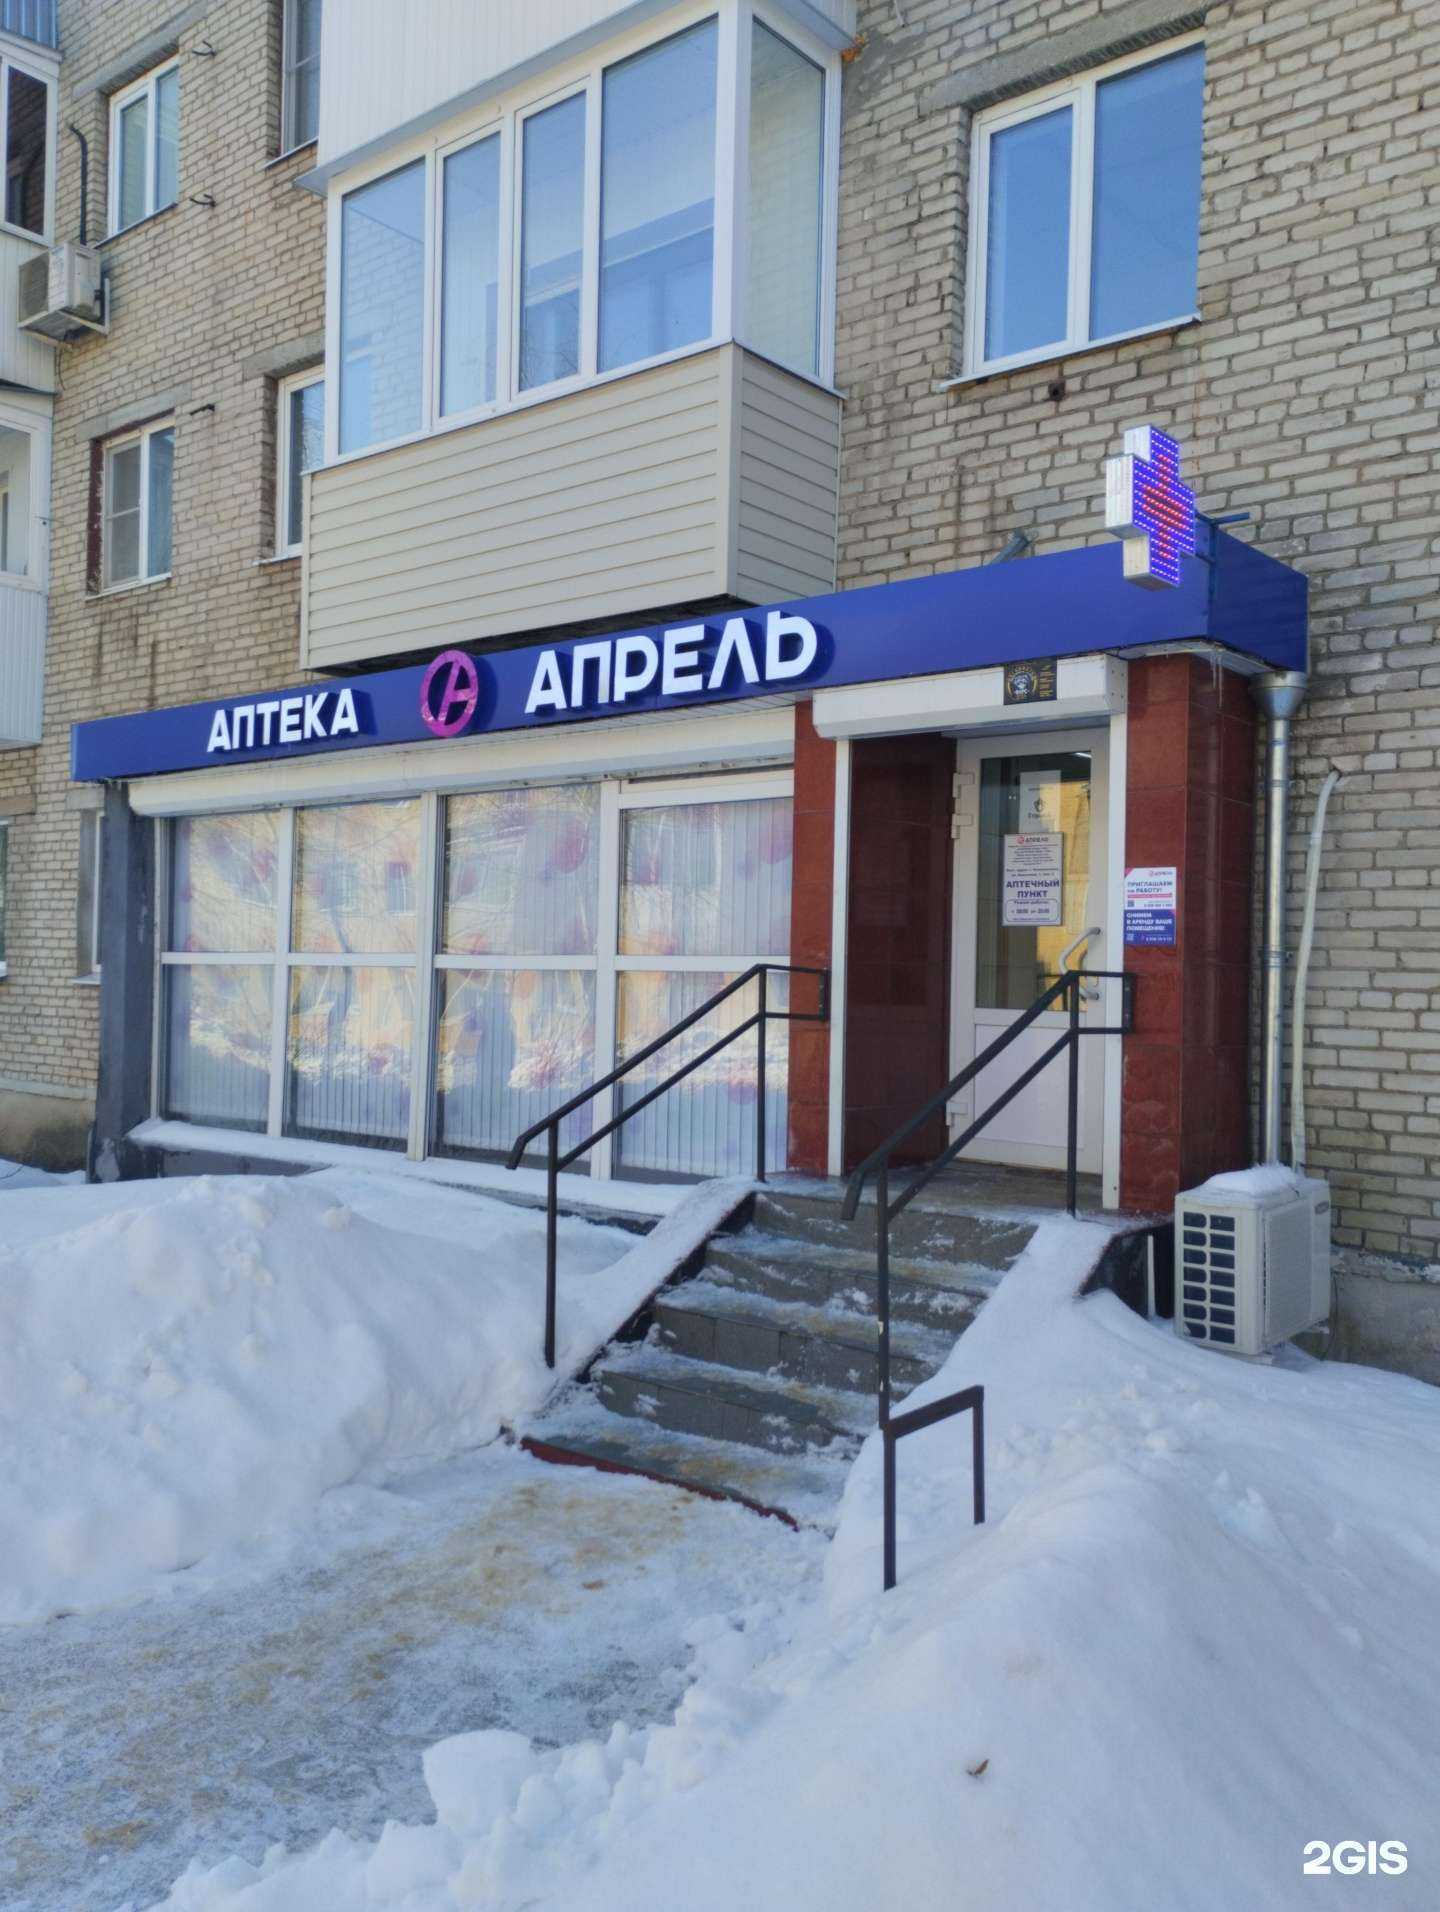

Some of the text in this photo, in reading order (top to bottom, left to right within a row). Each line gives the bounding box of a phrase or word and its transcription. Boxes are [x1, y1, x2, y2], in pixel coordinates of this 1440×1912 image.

[206, 611, 818, 754] АПТЕКА АПРЕЛЬ
[1006, 879, 1060, 889] АПТЕЧНЫЙ
[1017, 890, 1048, 899] ПУНКТ
